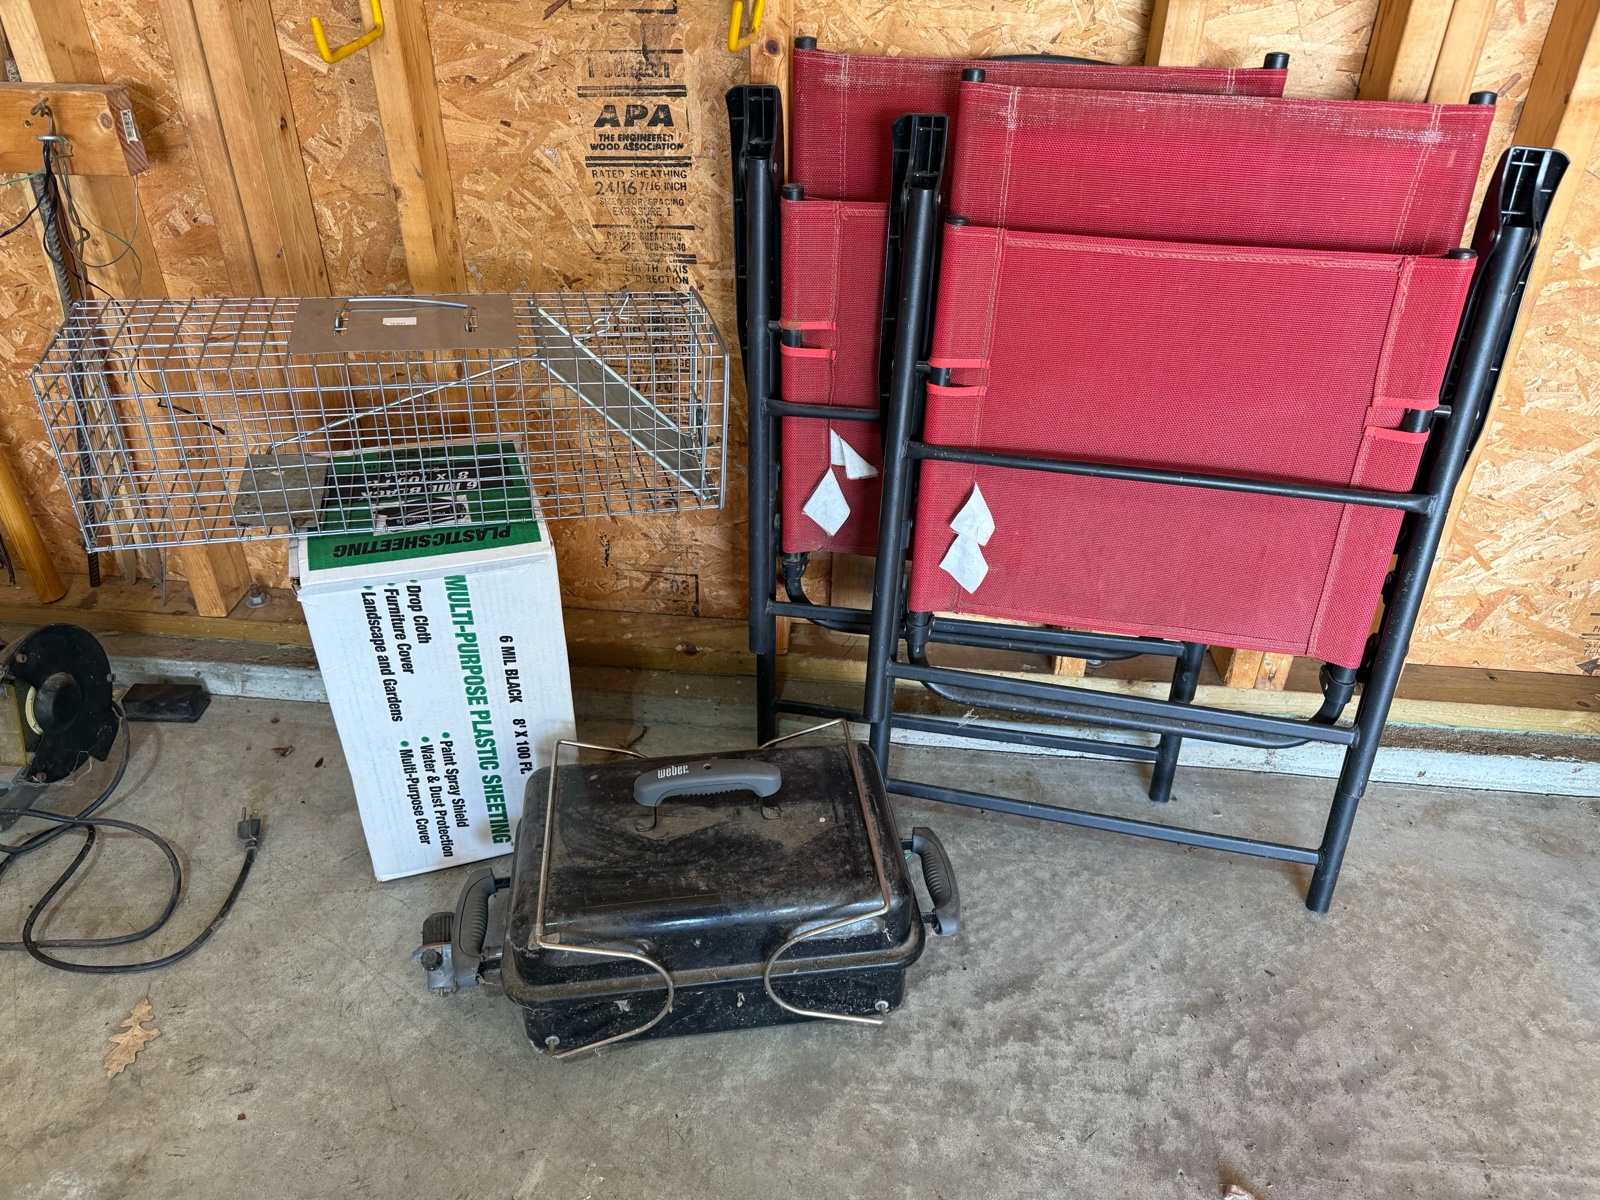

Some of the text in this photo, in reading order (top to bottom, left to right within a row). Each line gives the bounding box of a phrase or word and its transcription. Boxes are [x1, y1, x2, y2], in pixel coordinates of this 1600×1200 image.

[594, 104, 674, 127] APA
[590, 142, 684, 151] WOOD ASSOCIATION
[598, 133, 674, 142] THE ENGINEERED
[592, 169, 687, 179] RATED SHEATHING
[639, 182, 661, 191] 7/16
[663, 182, 687, 191] INCH
[647, 198, 685, 207] SPACING
[666, 207, 672, 217] 1
[665, 264, 688, 274] AXIS
[635, 274, 689, 285] DIRECTION
[358, 481, 478, 501] 6 MIL BLACK
[406, 585, 432, 644] Drop Cloth
[383, 588, 415, 675] Furniture Cover
[499, 635, 514, 644] 6
[360, 590, 403, 722] Landscape and Gardens
[500, 646, 515, 666] MIL
[504, 669, 523, 704] BLACK
[443, 574, 512, 845] MULTI-PURPOSE PLASTIC SHEETING
[516, 740, 532, 760] 100
[519, 761, 534, 775] Ft.
[439, 740, 470, 828] Paint Spray Shield
[399, 748, 431, 845] Multi-Purpose Cover
[420, 744, 454, 858] Water & Dust Protection
